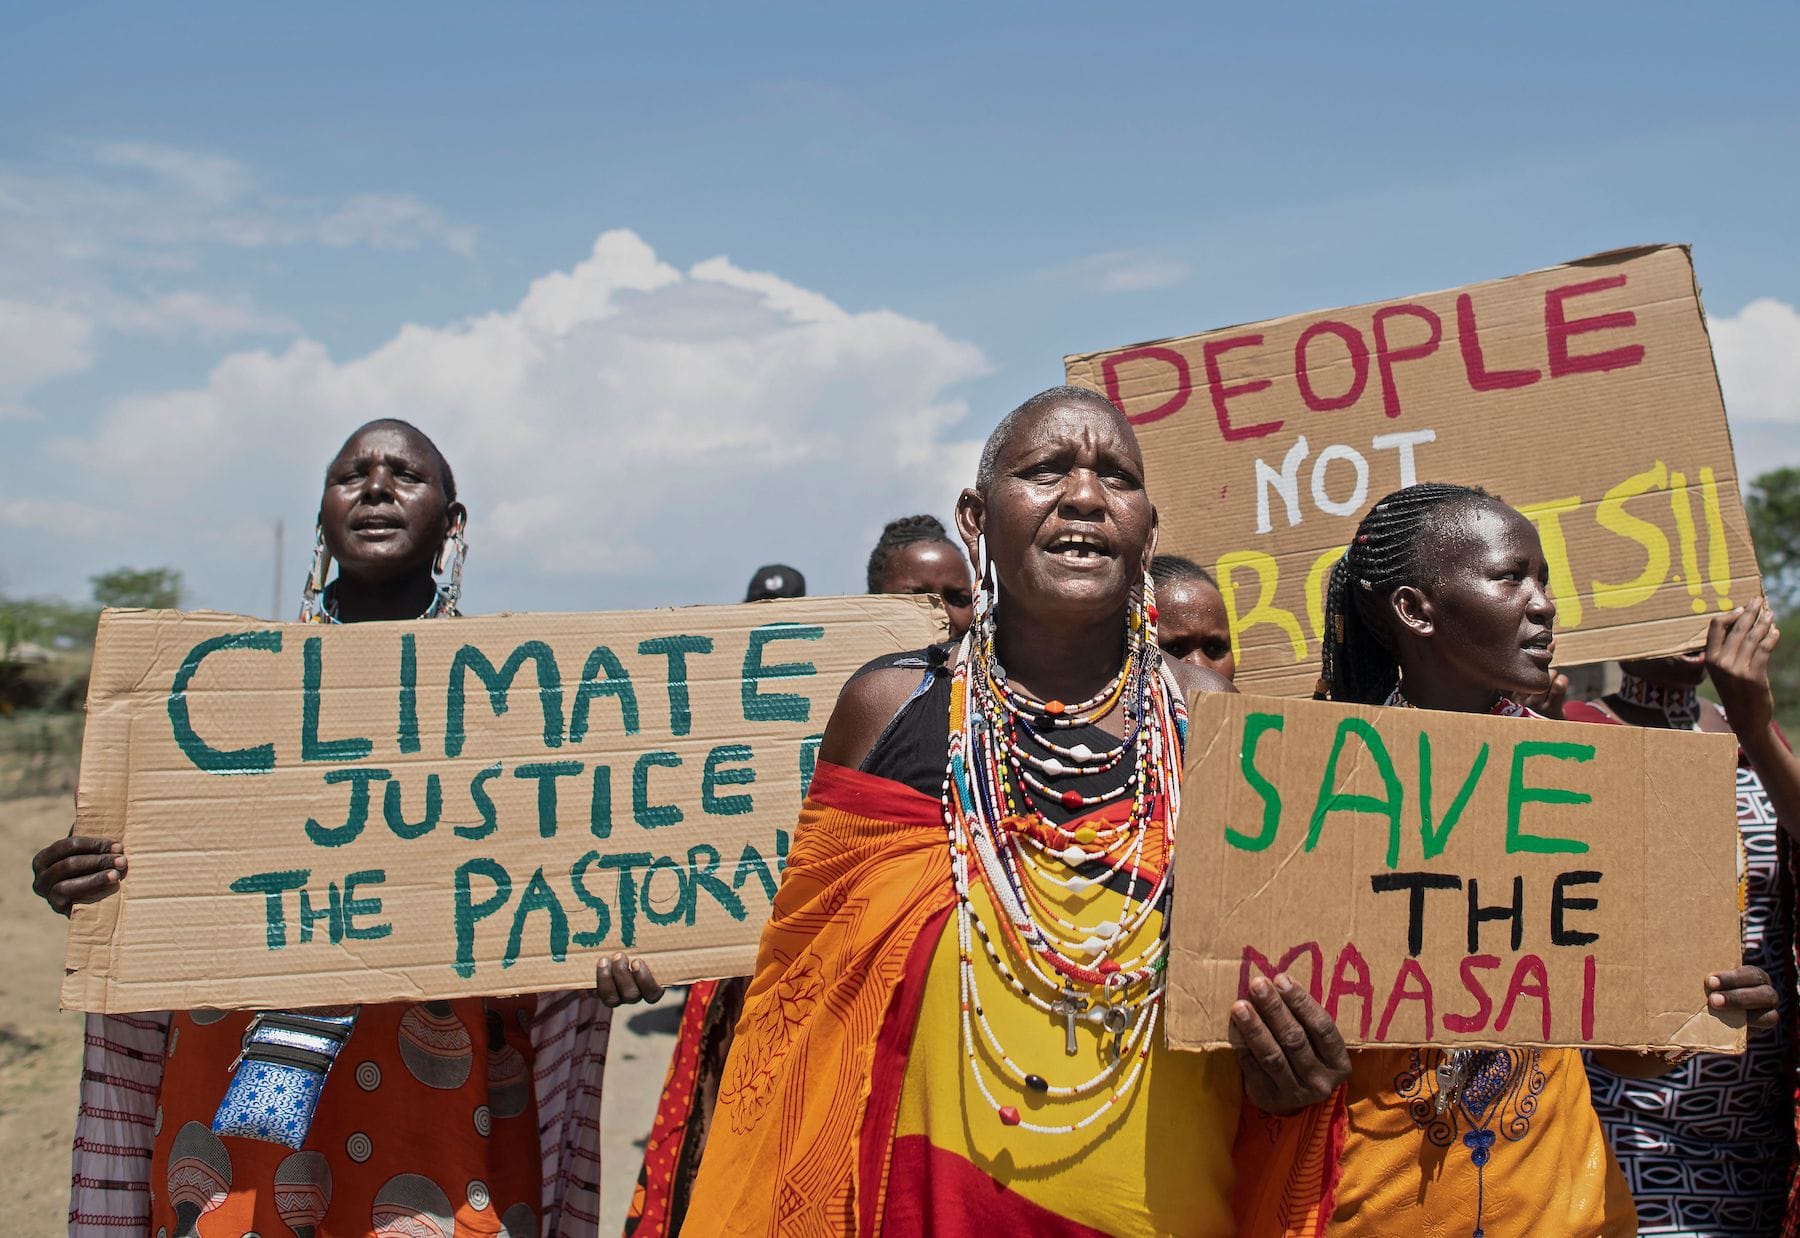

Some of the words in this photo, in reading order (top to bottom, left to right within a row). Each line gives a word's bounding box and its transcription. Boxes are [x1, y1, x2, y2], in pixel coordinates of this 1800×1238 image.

[1102, 274, 1645, 441] PEOPLE
[1255, 430, 1436, 534] NOT
[167, 622, 825, 776] CLIMATE
[304, 744, 757, 847] JUSTICE
[1225, 712, 1596, 869] SAVE
[229, 869, 392, 951] THE
[1371, 871, 1603, 957] THE
[1237, 941, 1596, 1042] MAASAI
